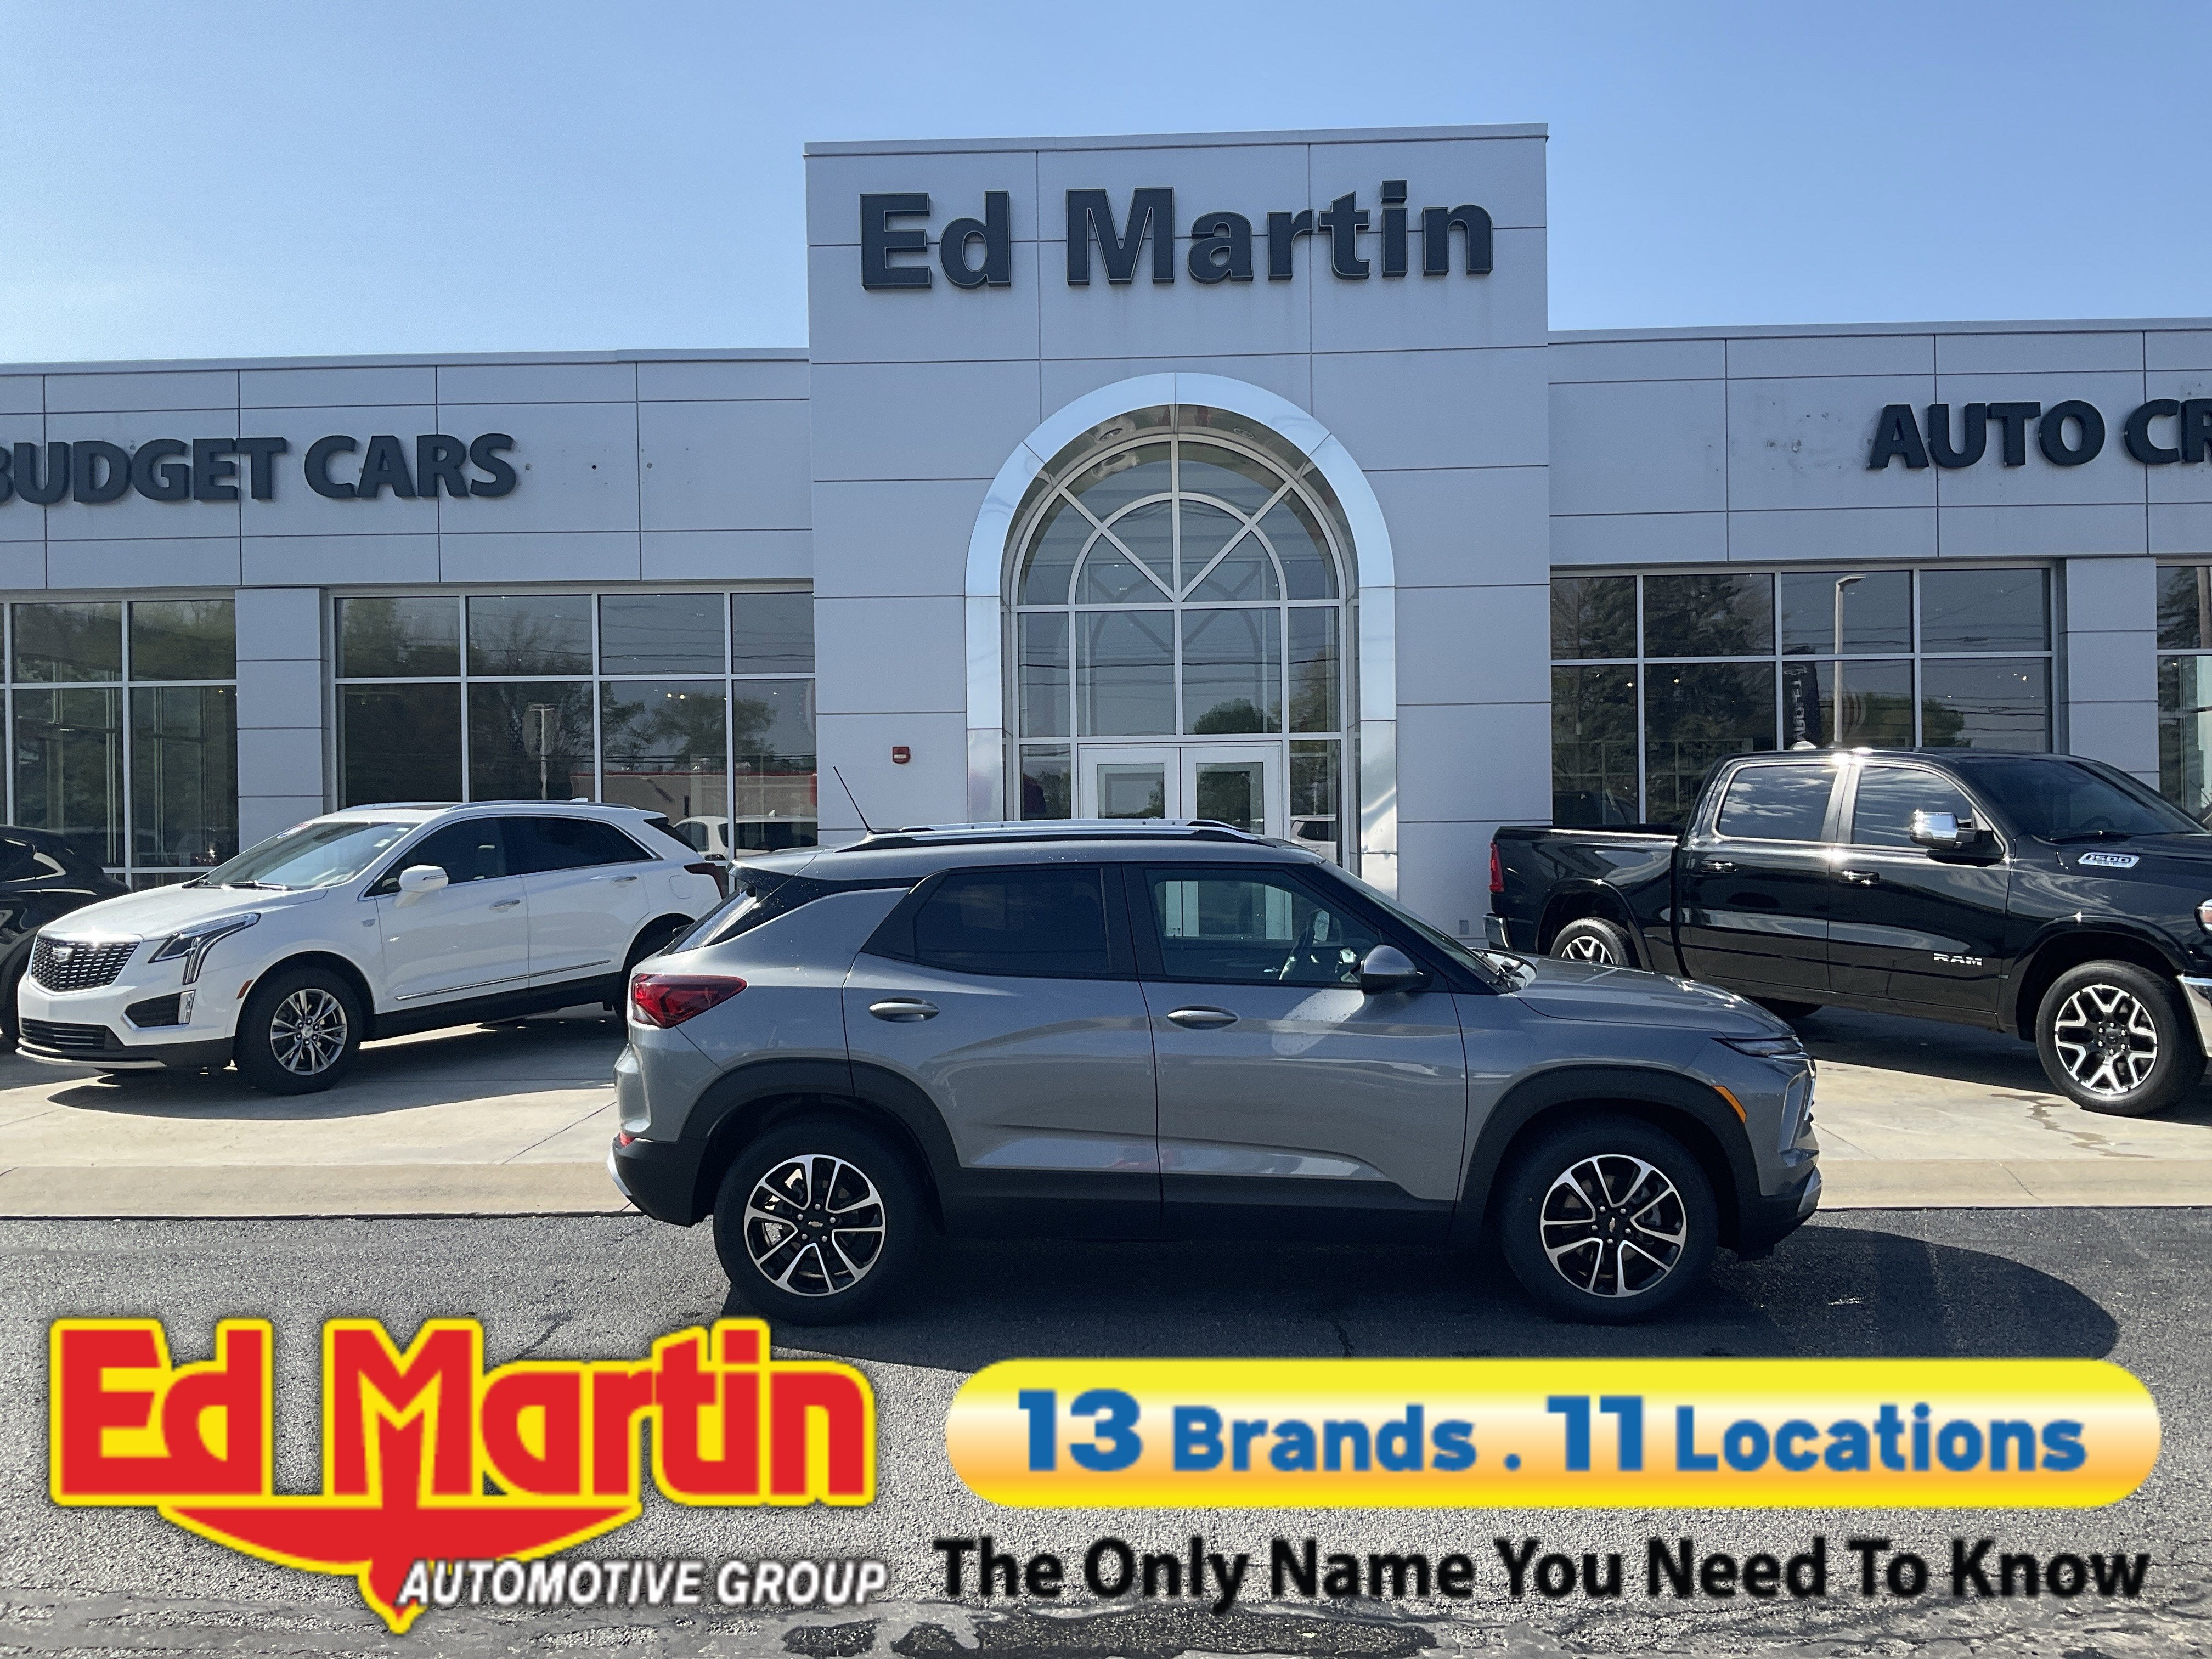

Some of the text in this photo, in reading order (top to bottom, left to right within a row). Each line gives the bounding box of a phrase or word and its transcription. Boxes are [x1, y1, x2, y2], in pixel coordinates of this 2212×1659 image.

[860, 180, 1494, 290] Ed Martin
[0, 433, 517, 505] UDGET CARS
[1866, 400, 2106, 469] AUTO
[1933, 953, 1983, 966] RAM
